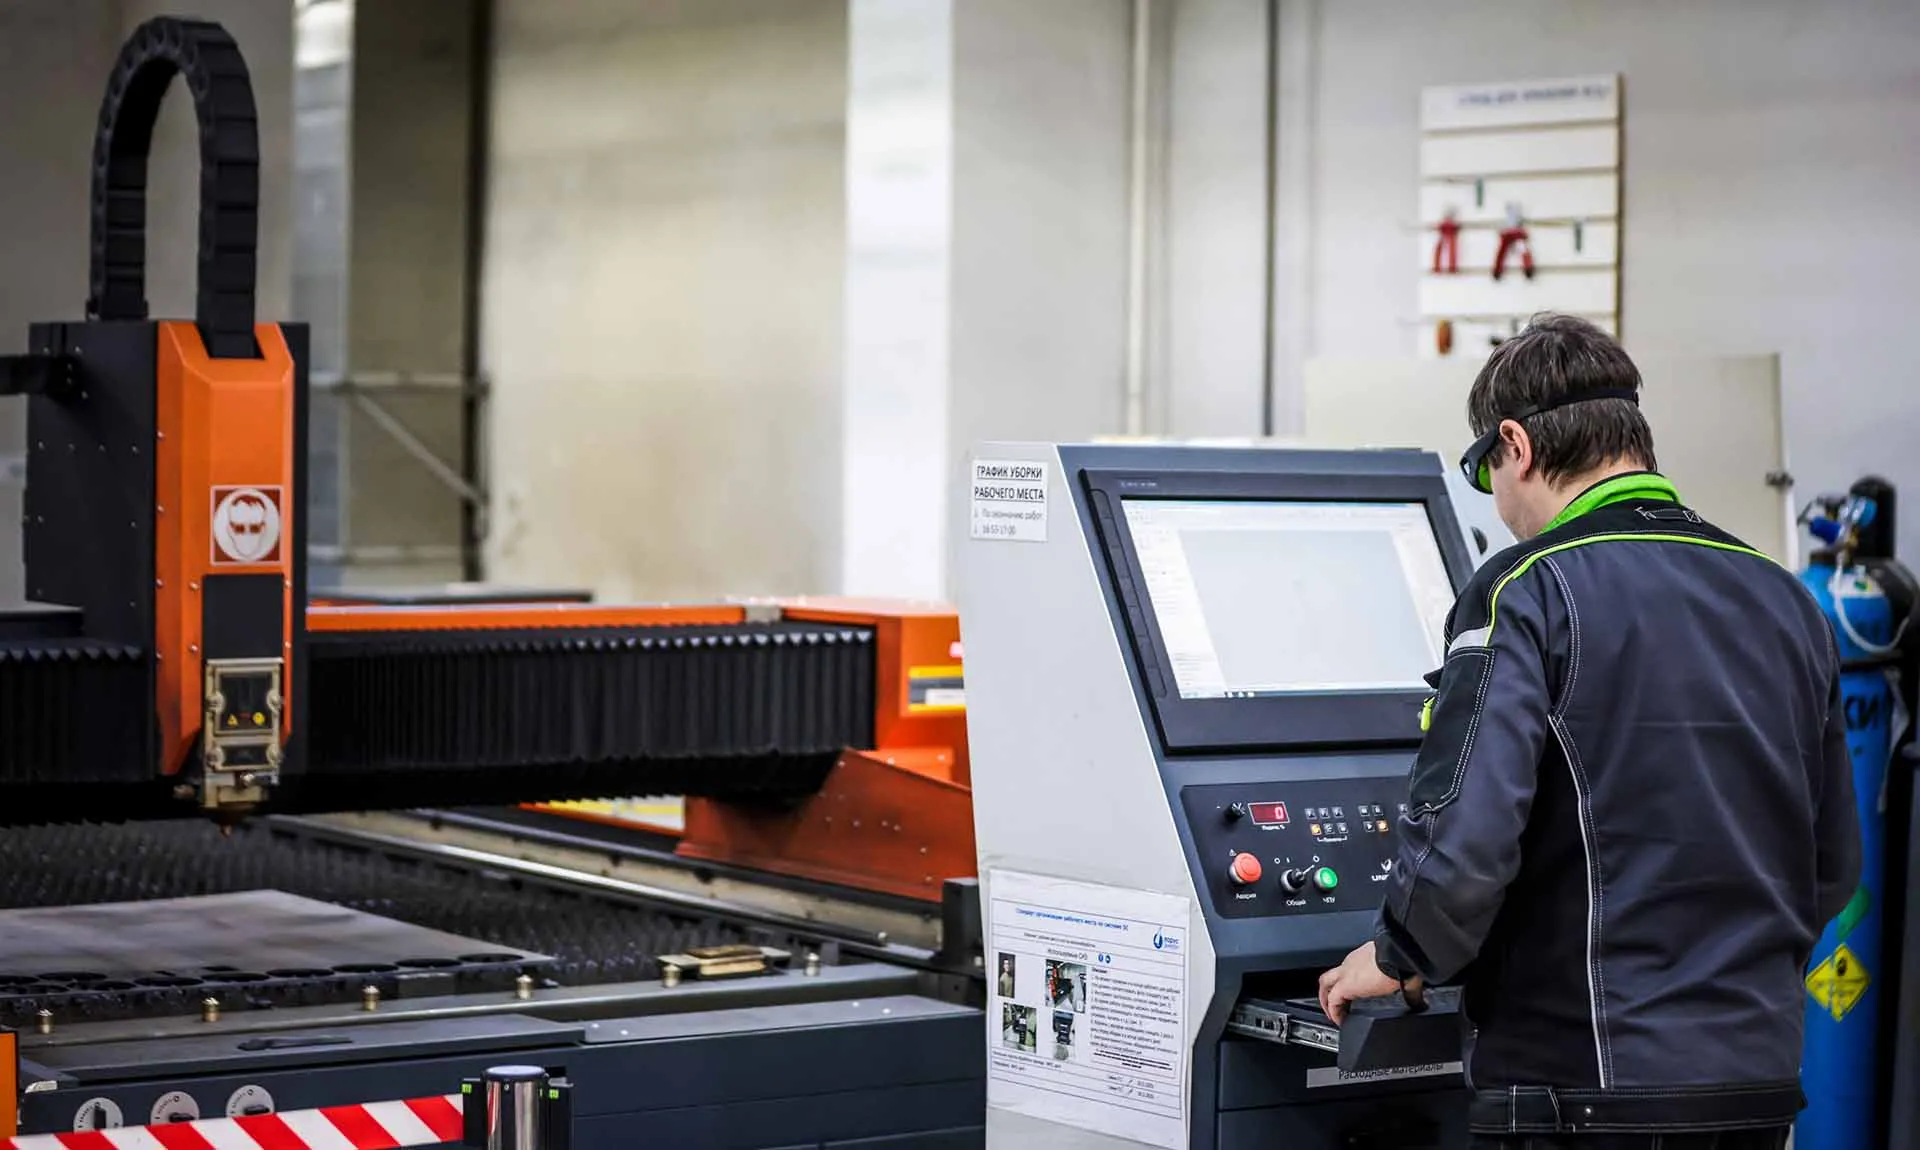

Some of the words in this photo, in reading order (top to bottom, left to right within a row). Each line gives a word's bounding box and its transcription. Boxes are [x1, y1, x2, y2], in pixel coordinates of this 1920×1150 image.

[976, 465, 1009, 477] ГРАФИК
[1010, 466, 1042, 478] УБОРКИ
[974, 486, 1015, 499] РАБОЧЕГО
[1016, 488, 1044, 500] МЕСТА
[1274, 806, 1285, 820] 0
[1339, 1066, 1391, 1080] Расходные
[1391, 1063, 1444, 1074] материалы
